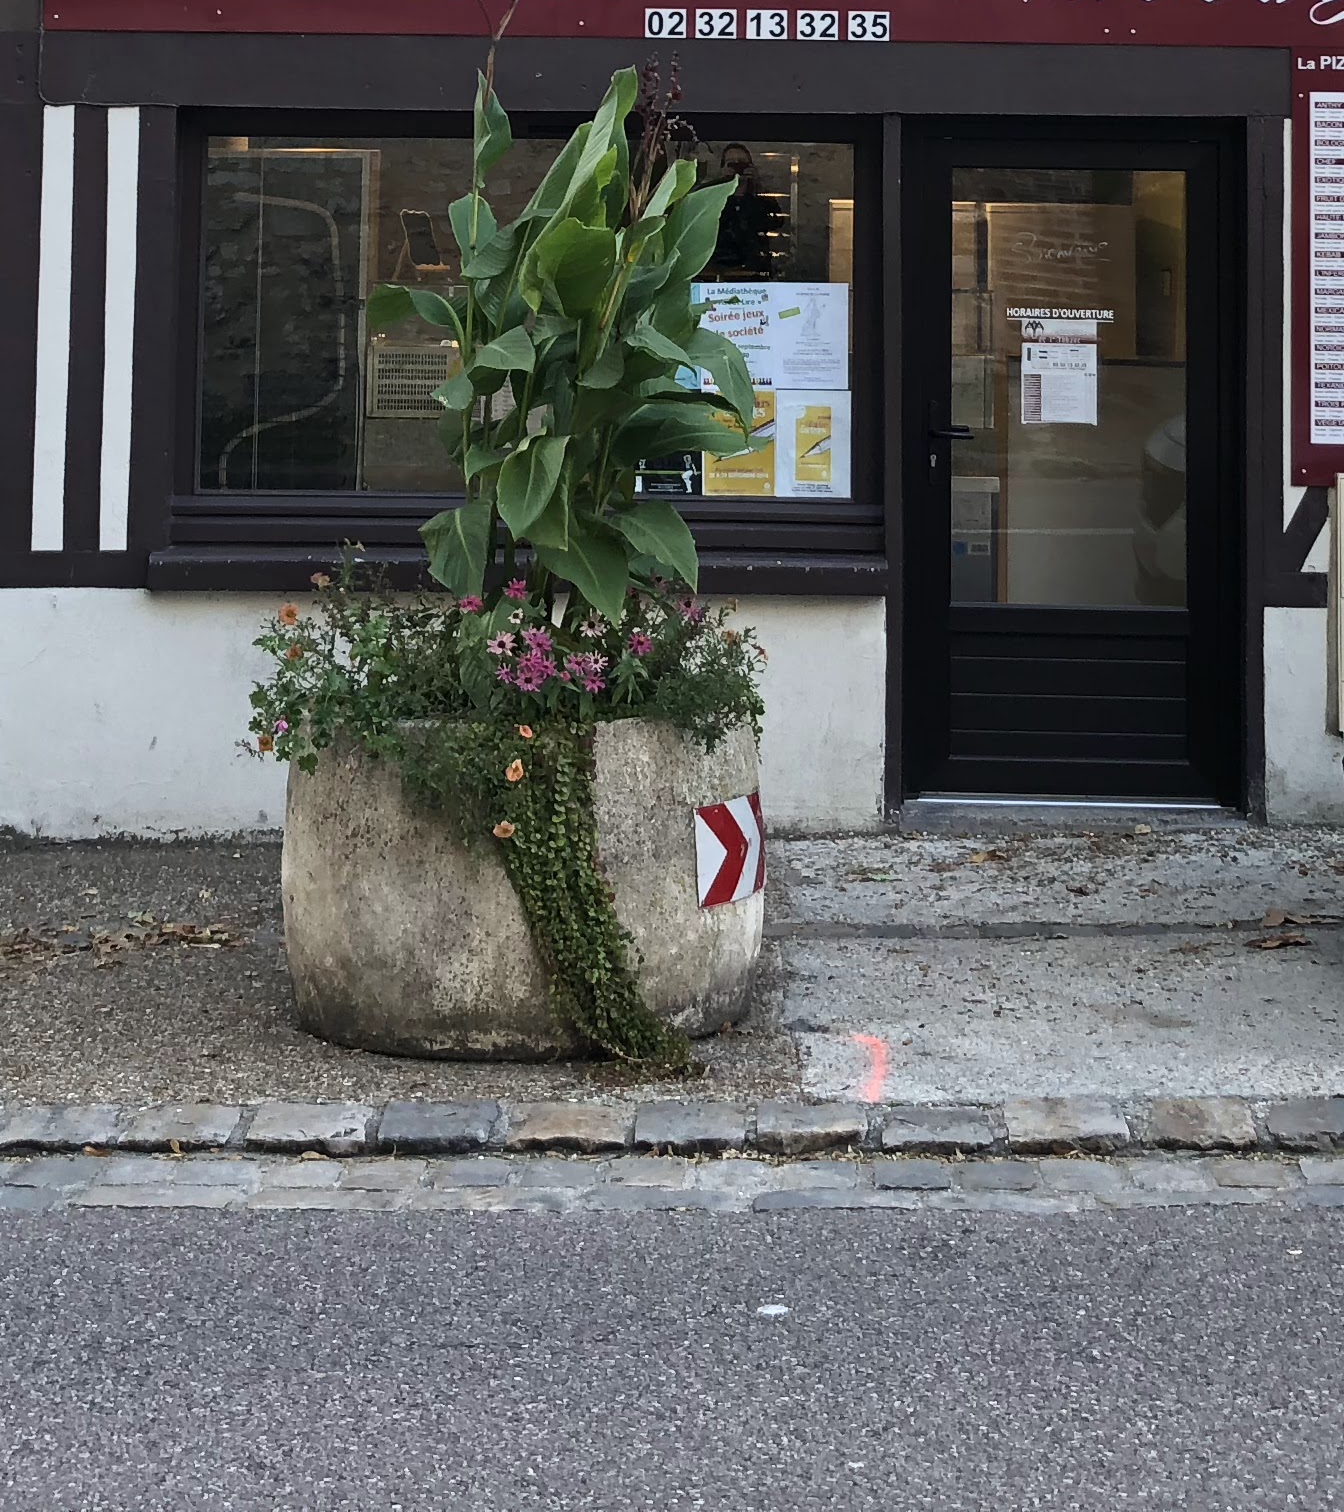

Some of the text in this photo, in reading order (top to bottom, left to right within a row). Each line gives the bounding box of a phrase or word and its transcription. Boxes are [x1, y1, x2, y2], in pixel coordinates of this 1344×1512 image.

[647, 11, 888, 39] 02 32 13 32 35
[1297, 56, 1315, 70] La
[708, 308, 764, 323] Soirée jeux
[1006, 308, 1114, 319] HORAIRES D'OUVERTURE
[728, 326, 764, 338] société
